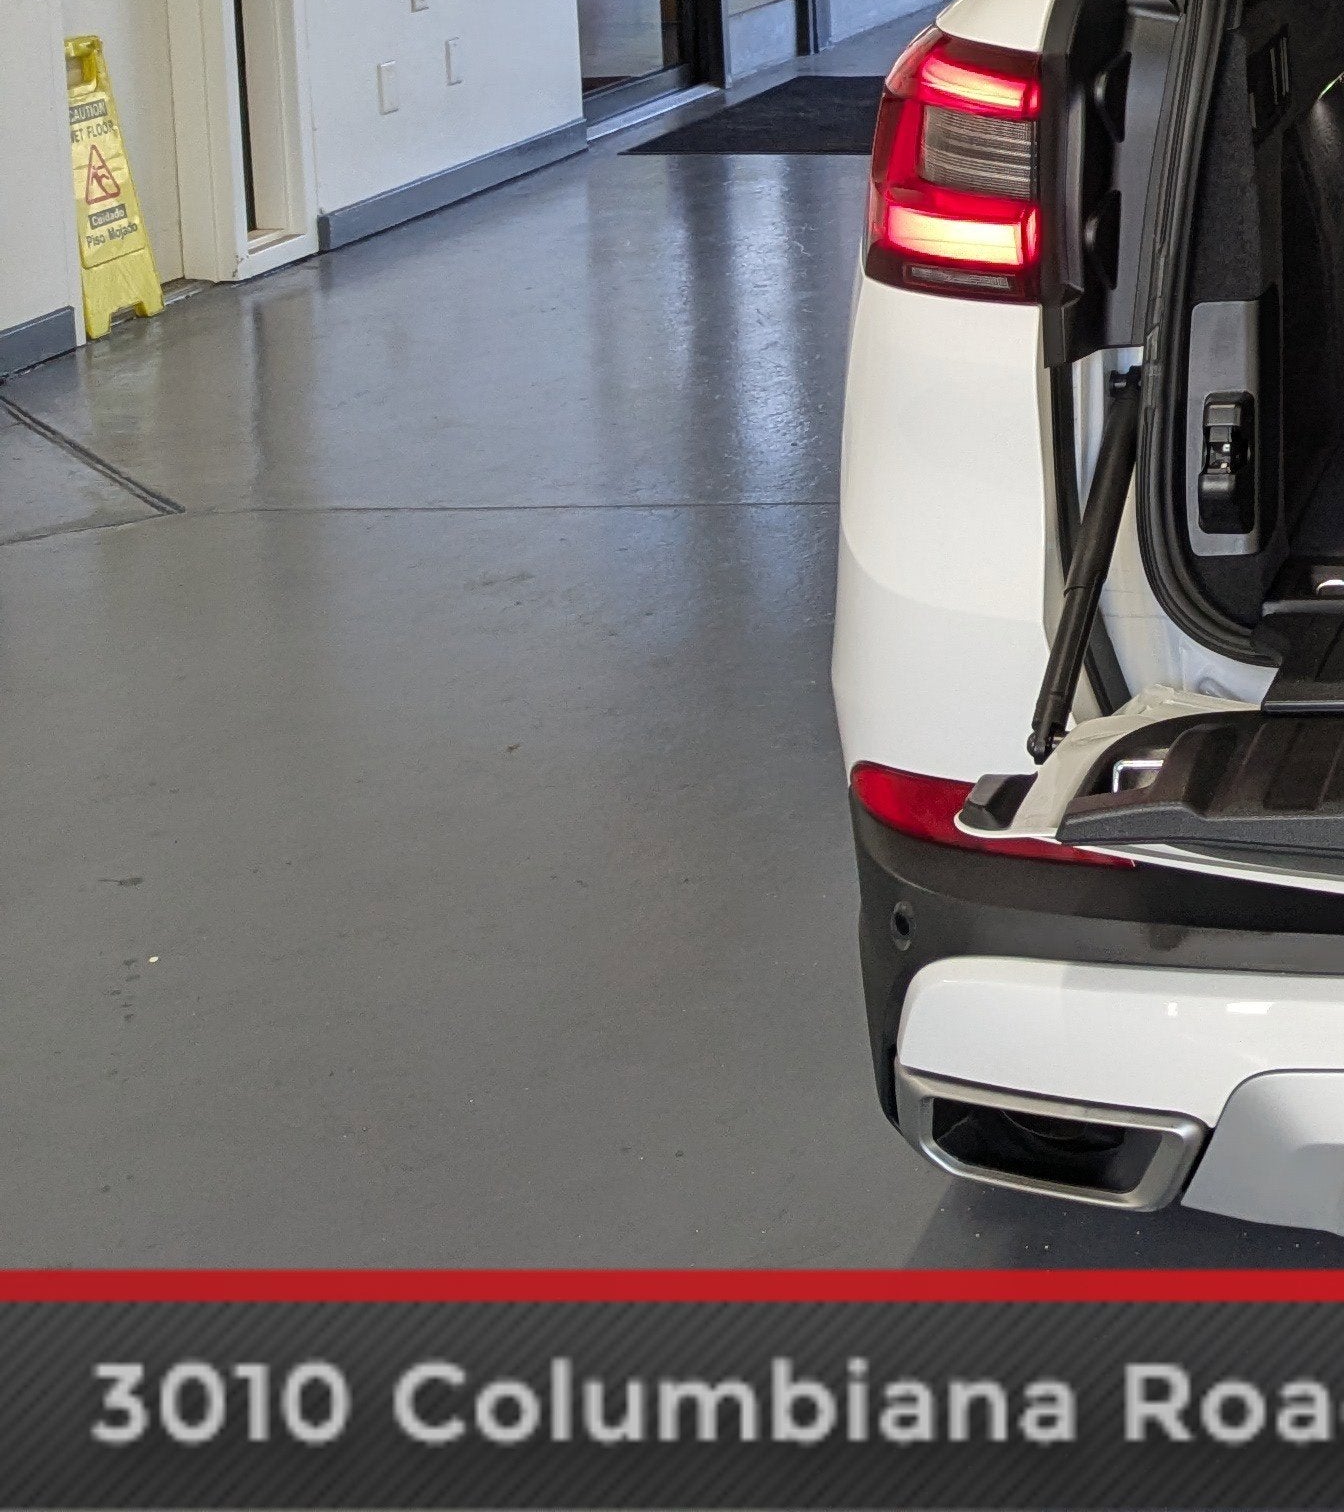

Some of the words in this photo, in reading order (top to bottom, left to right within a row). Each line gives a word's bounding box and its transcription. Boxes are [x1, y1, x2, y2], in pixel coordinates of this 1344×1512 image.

[70, 101, 106, 123] AUTION
[86, 120, 115, 138] FLOOR
[91, 207, 125, 226] Cuidado
[86, 234, 105, 248] Piso
[108, 223, 138, 240] Mojado
